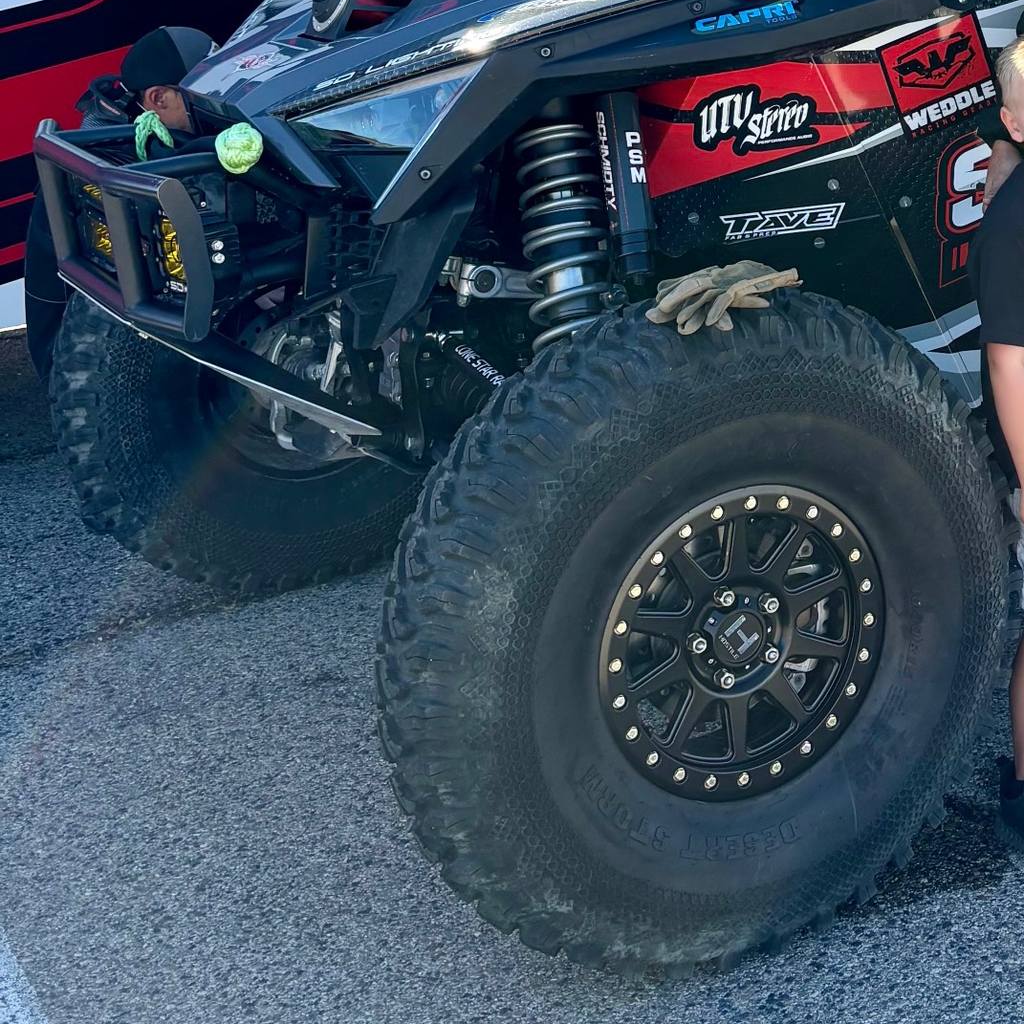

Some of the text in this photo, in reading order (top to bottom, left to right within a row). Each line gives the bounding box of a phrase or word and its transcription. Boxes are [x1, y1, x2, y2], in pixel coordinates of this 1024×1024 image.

[695, 1, 795, 32] CAPRI
[700, 91, 754, 143] UTV
[905, 80, 996, 131] WEDDLE
[596, 112, 617, 211] SCHMIDTY
[720, 203, 845, 235] TAVE
[680, 816, 802, 861] DESERT
